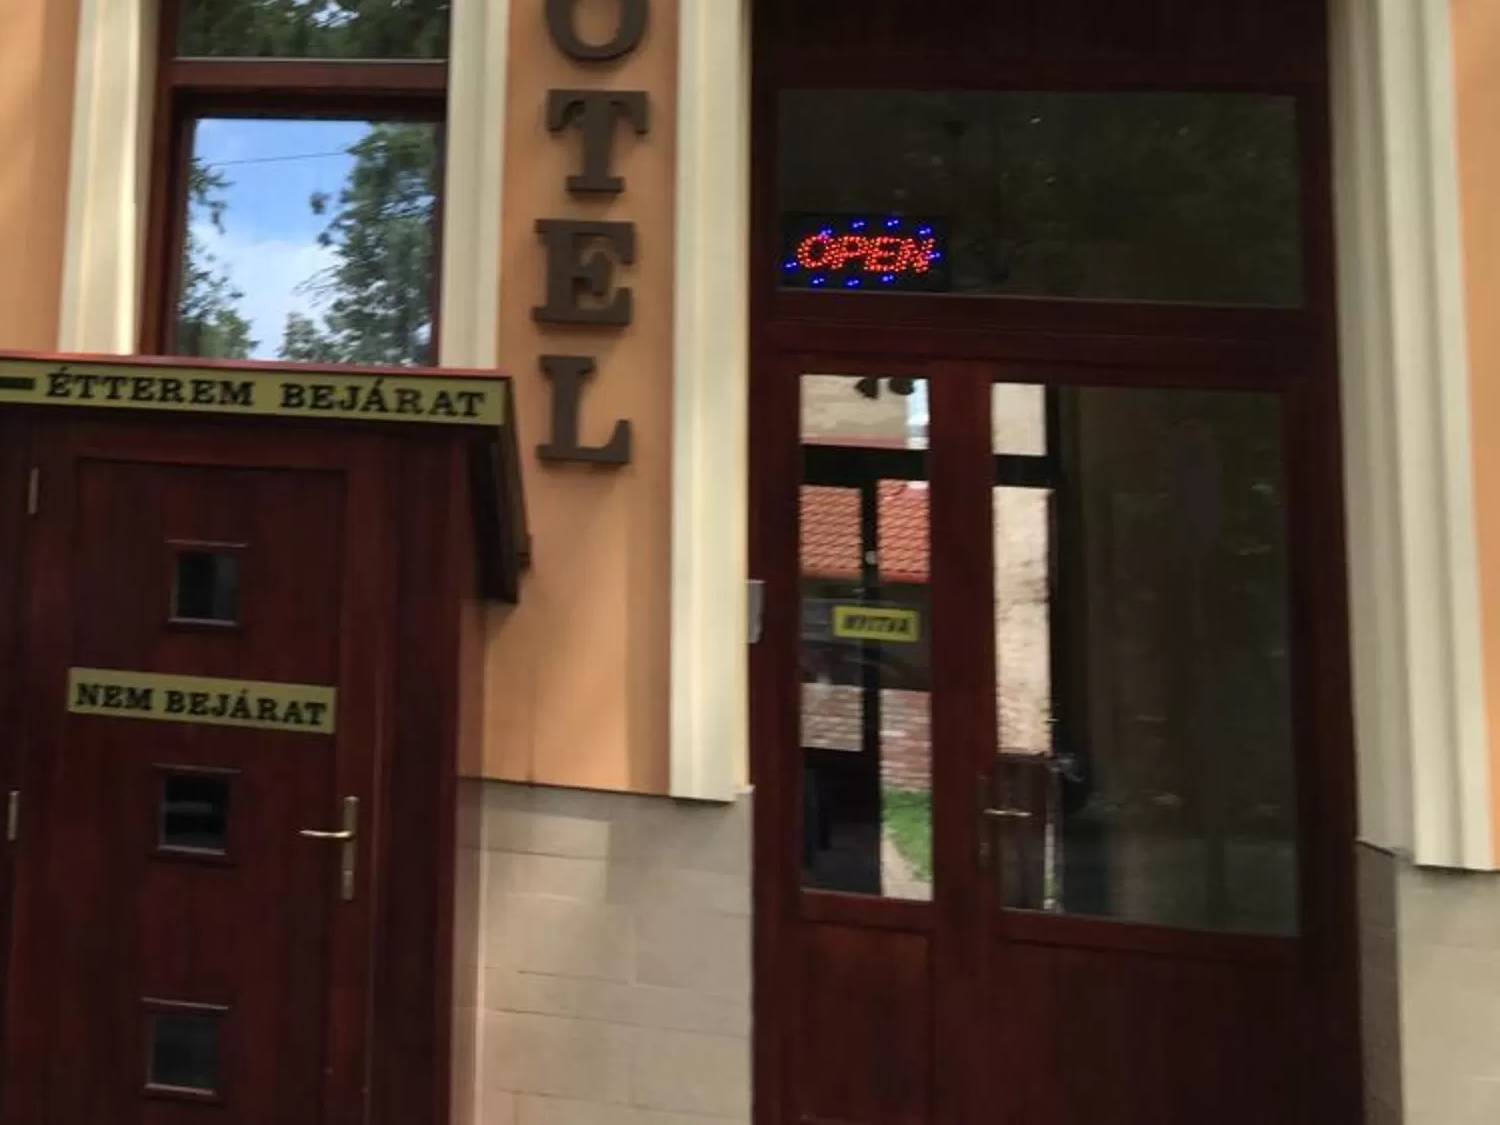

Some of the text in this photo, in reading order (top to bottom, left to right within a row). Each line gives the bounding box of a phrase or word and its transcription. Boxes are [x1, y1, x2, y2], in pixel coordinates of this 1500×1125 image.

[797, 235, 936, 274] OPEN
[45, 367, 485, 417] ÉTTEREM BEJÁRAT
[75, 682, 328, 727] NEM BEJÁRAT
